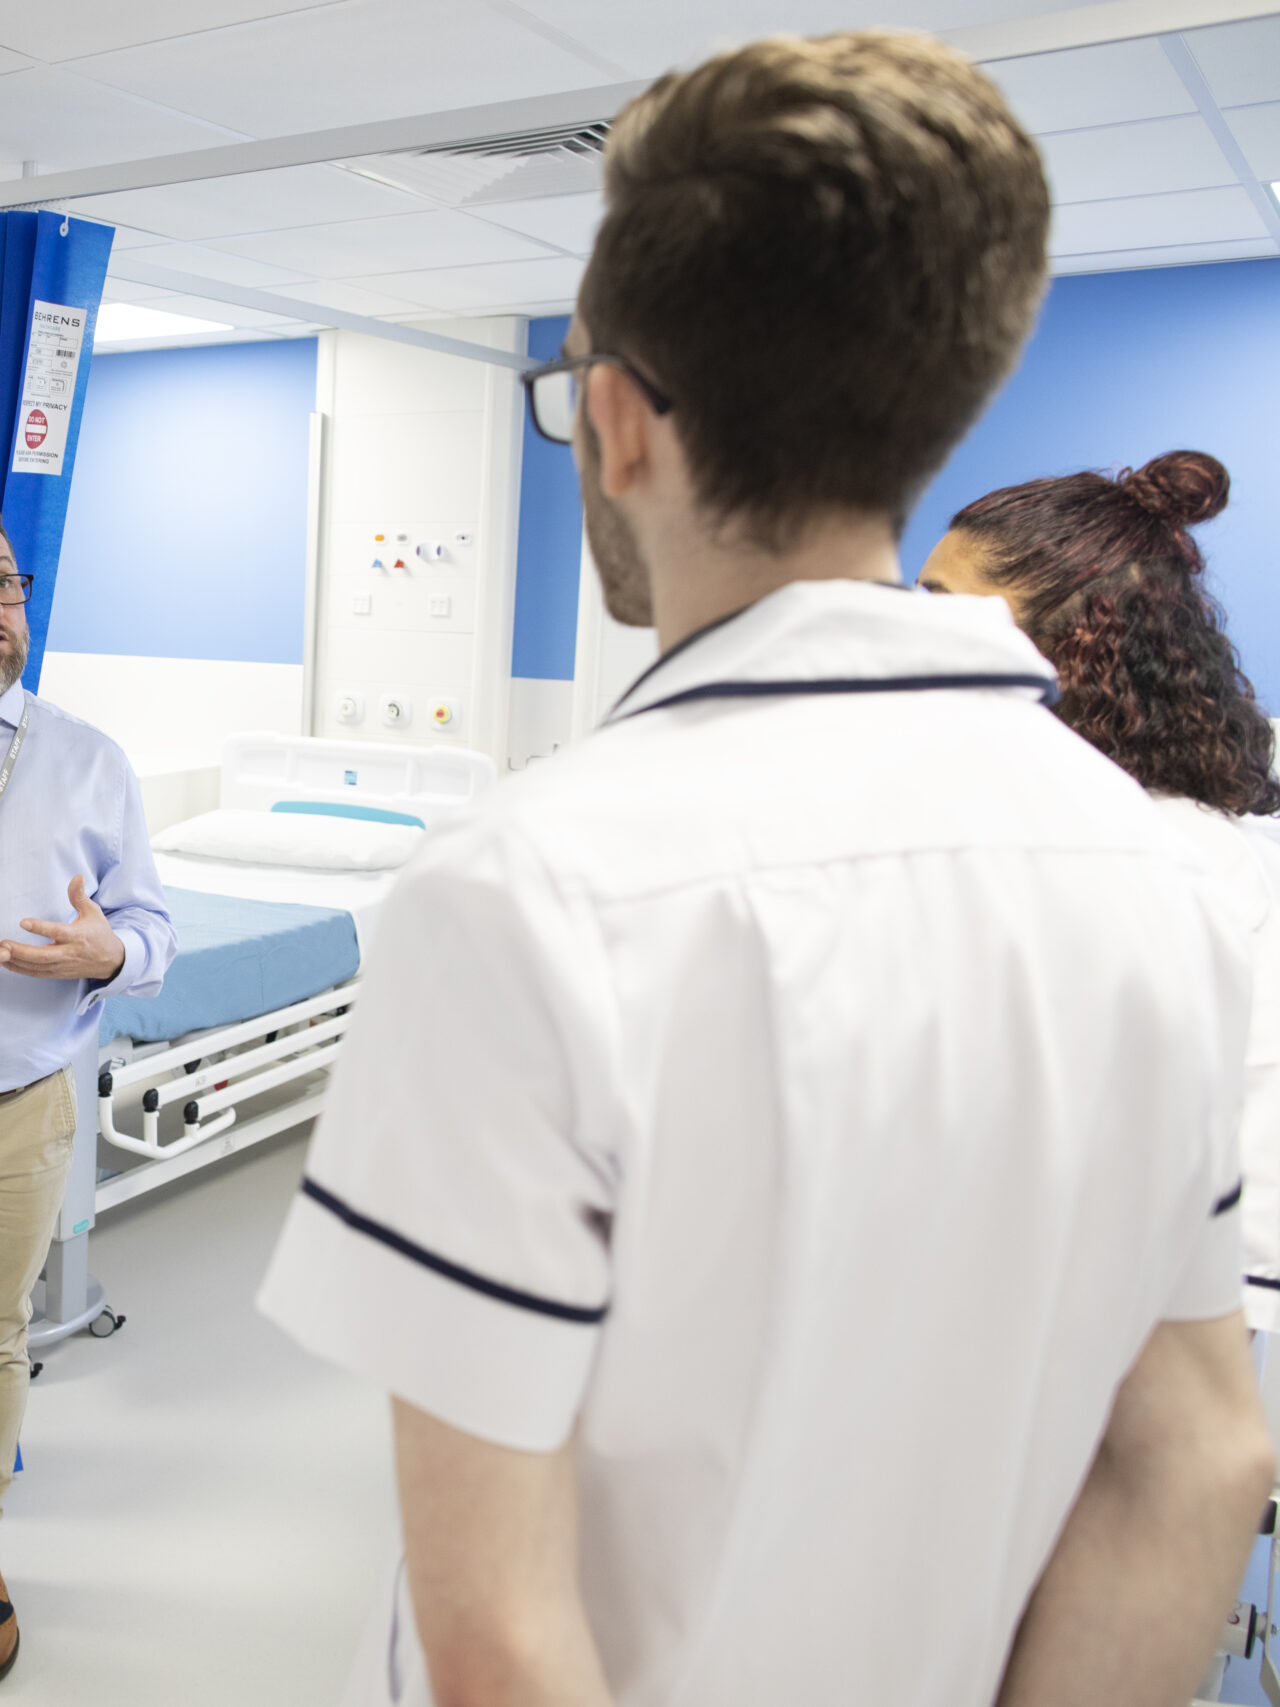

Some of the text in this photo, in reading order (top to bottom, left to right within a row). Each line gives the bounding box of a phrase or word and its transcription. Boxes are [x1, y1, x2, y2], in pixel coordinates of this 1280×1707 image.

[34, 311, 81, 328] BEHRENS
[43, 402, 68, 411] PRIVACY
[27, 435, 42, 443] ENTER
[9, 737, 21, 760] STAFF
